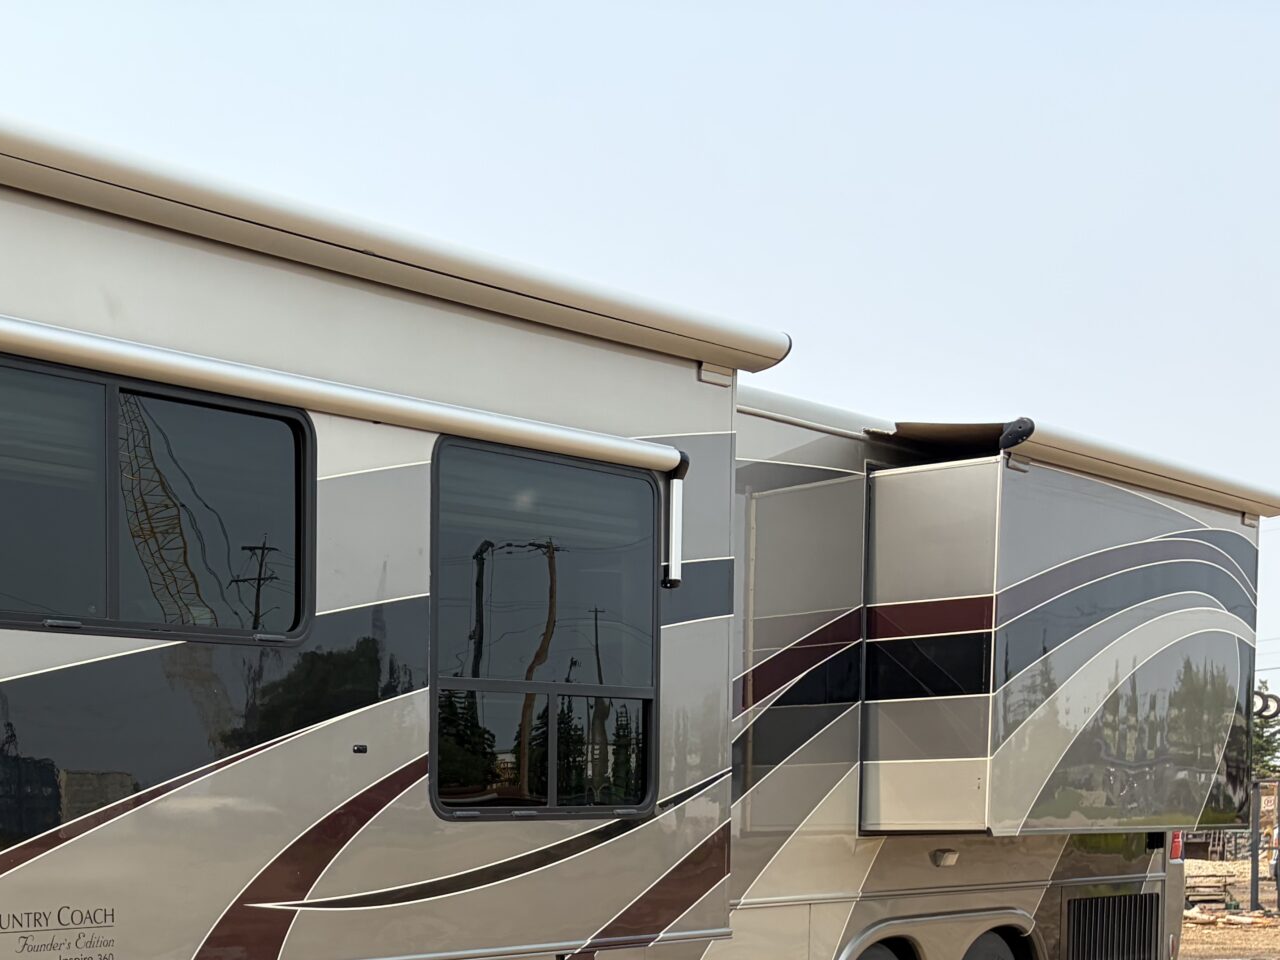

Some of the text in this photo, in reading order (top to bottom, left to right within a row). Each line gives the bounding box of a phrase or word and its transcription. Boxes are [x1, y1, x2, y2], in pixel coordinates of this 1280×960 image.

[57, 905, 115, 927] COACH
[15, 932, 115, 954] Founder's Edition
